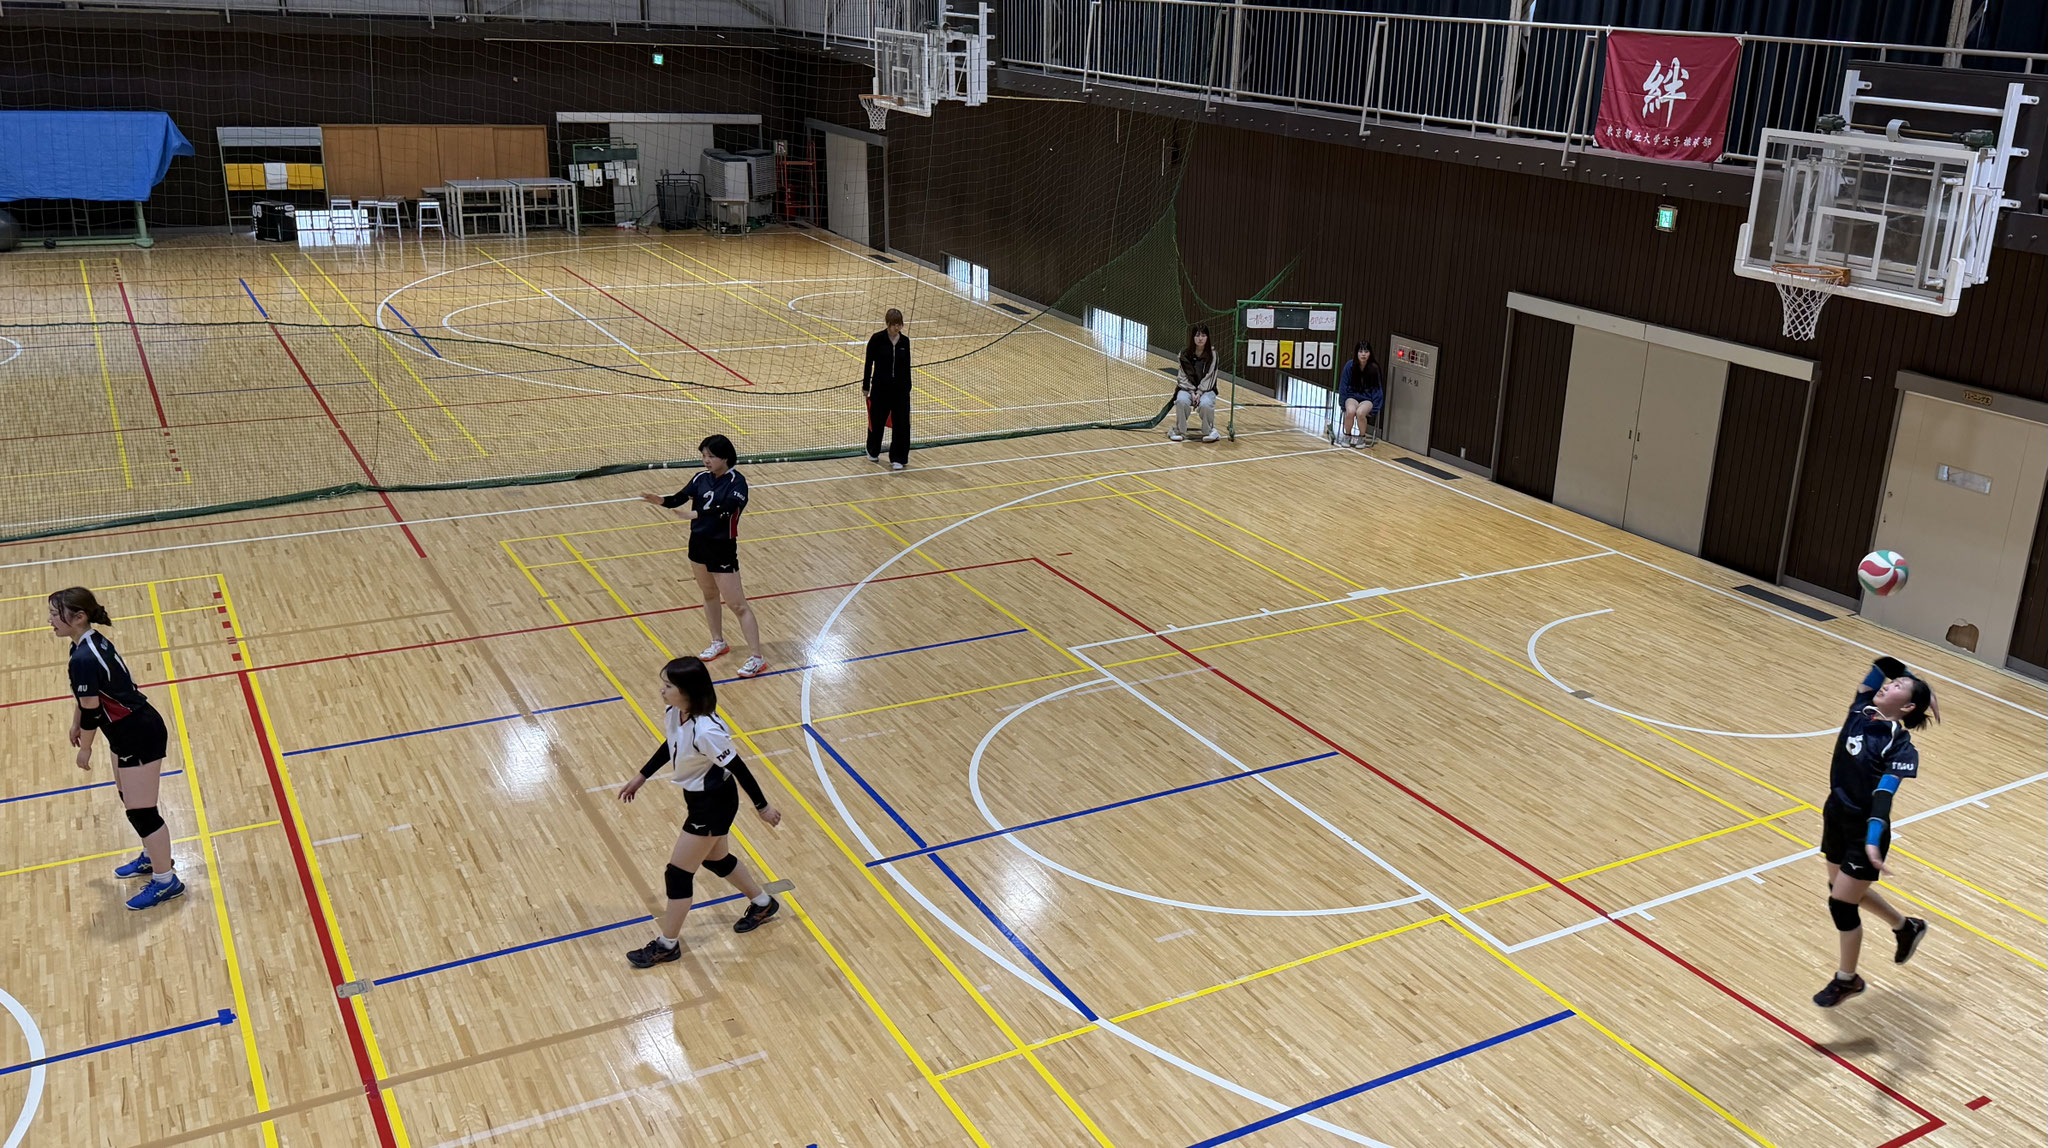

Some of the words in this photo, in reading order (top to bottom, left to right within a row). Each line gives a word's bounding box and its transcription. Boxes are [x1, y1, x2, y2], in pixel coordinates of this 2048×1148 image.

[1642, 57, 1689, 128] 絆
[595, 177, 601, 185] 4
[630, 176, 636, 184] 4
[1250, 351, 1275, 365] 16
[1281, 353, 1290, 366] 2
[1305, 353, 1331, 367] 20
[702, 490, 715, 511] 2
[1892, 762, 1914, 771] TMU
